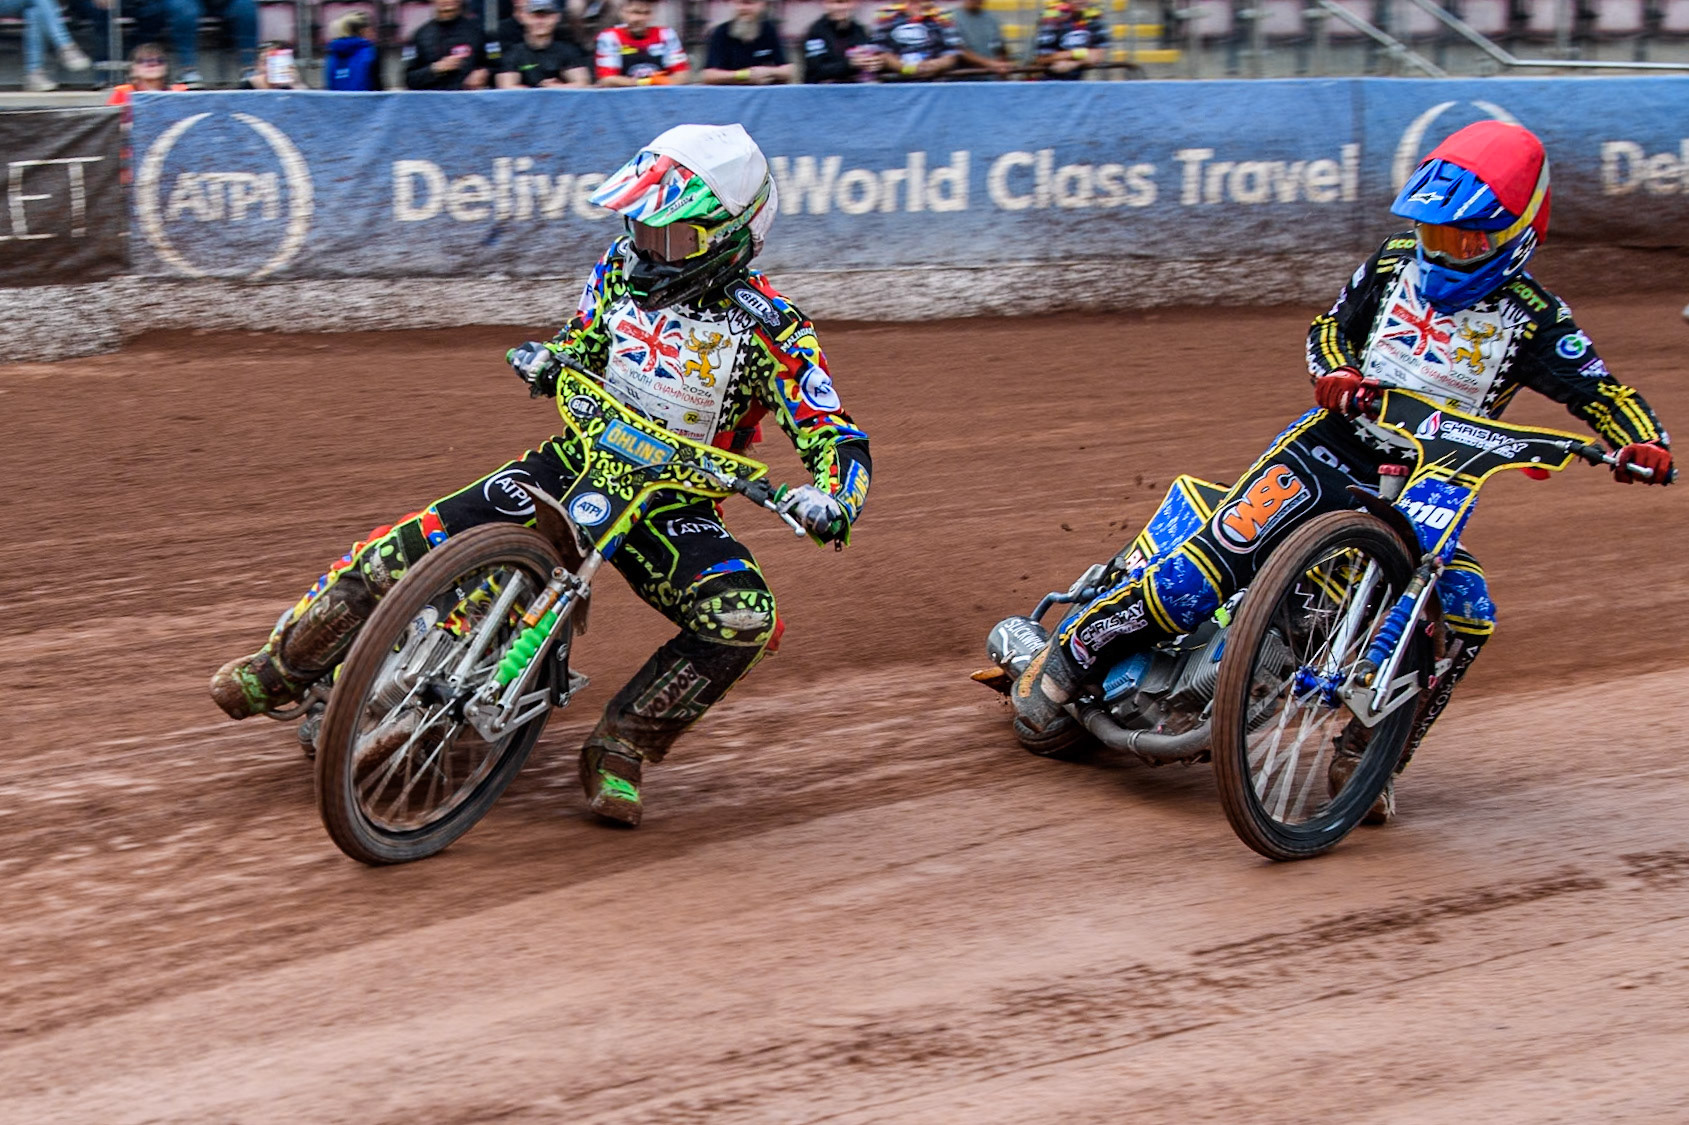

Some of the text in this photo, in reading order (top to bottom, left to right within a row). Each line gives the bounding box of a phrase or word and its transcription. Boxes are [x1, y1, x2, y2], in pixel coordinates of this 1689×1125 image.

[392, 144, 1359, 222] Delive World Class Travel
[1387, 238, 1416, 250] SCO
[629, 368, 652, 386] YOUTH
[653, 382, 715, 407] CHAMPIONSHIP
[683, 384, 711, 398] 2024
[1440, 420, 1490, 441] CHRIS
[495, 477, 533, 507] ATPI
[577, 501, 604, 518] ATPI
[1004, 618, 1047, 654] SLICKWH
